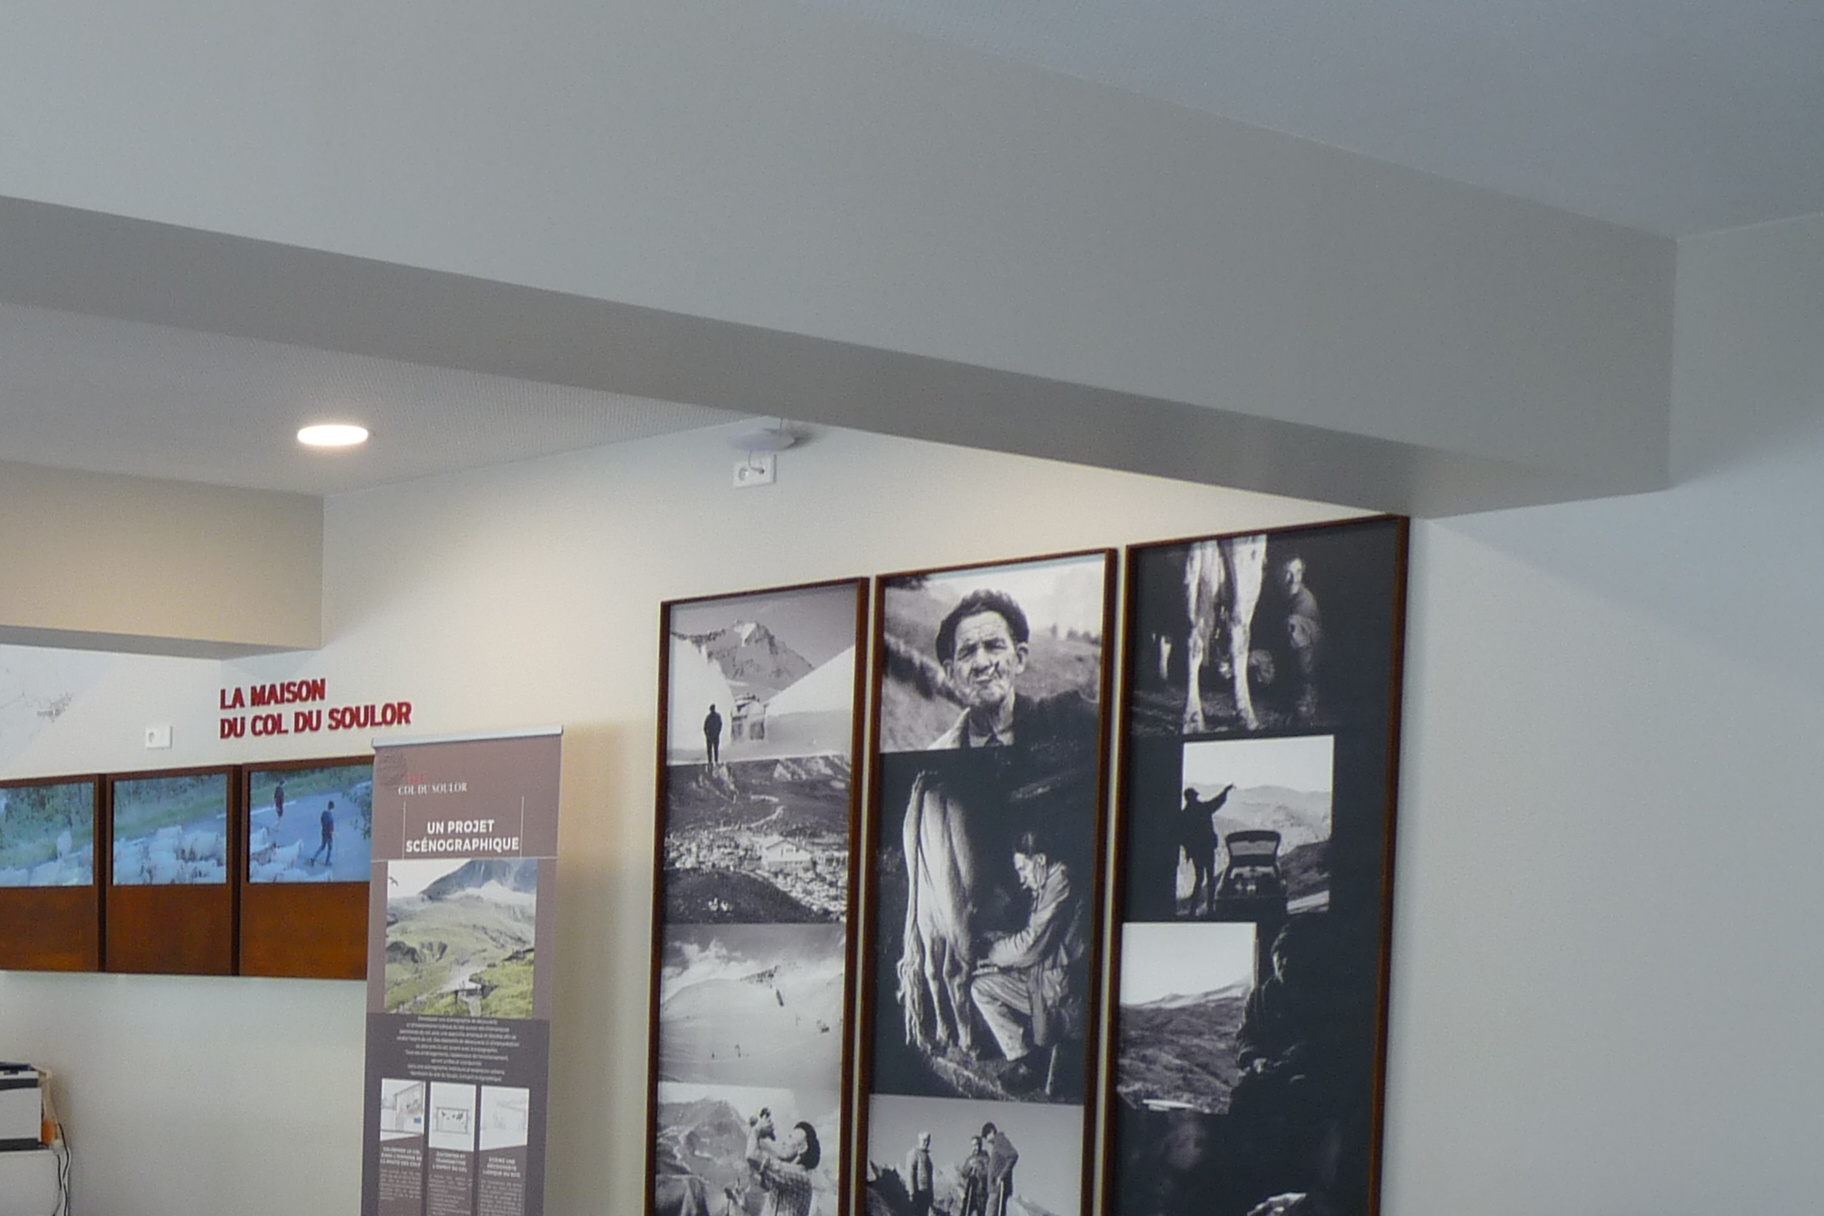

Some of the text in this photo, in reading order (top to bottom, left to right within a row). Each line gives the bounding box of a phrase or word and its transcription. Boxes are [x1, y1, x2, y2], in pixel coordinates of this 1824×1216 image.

[219, 678, 326, 710] LA MAISON
[219, 701, 412, 739] DU COL DU SOULOR
[398, 782, 468, 795] COL DU SOULOR
[427, 819, 495, 834] UN PROJET
[405, 836, 520, 853] SCÉNOGRAPHIQUE
